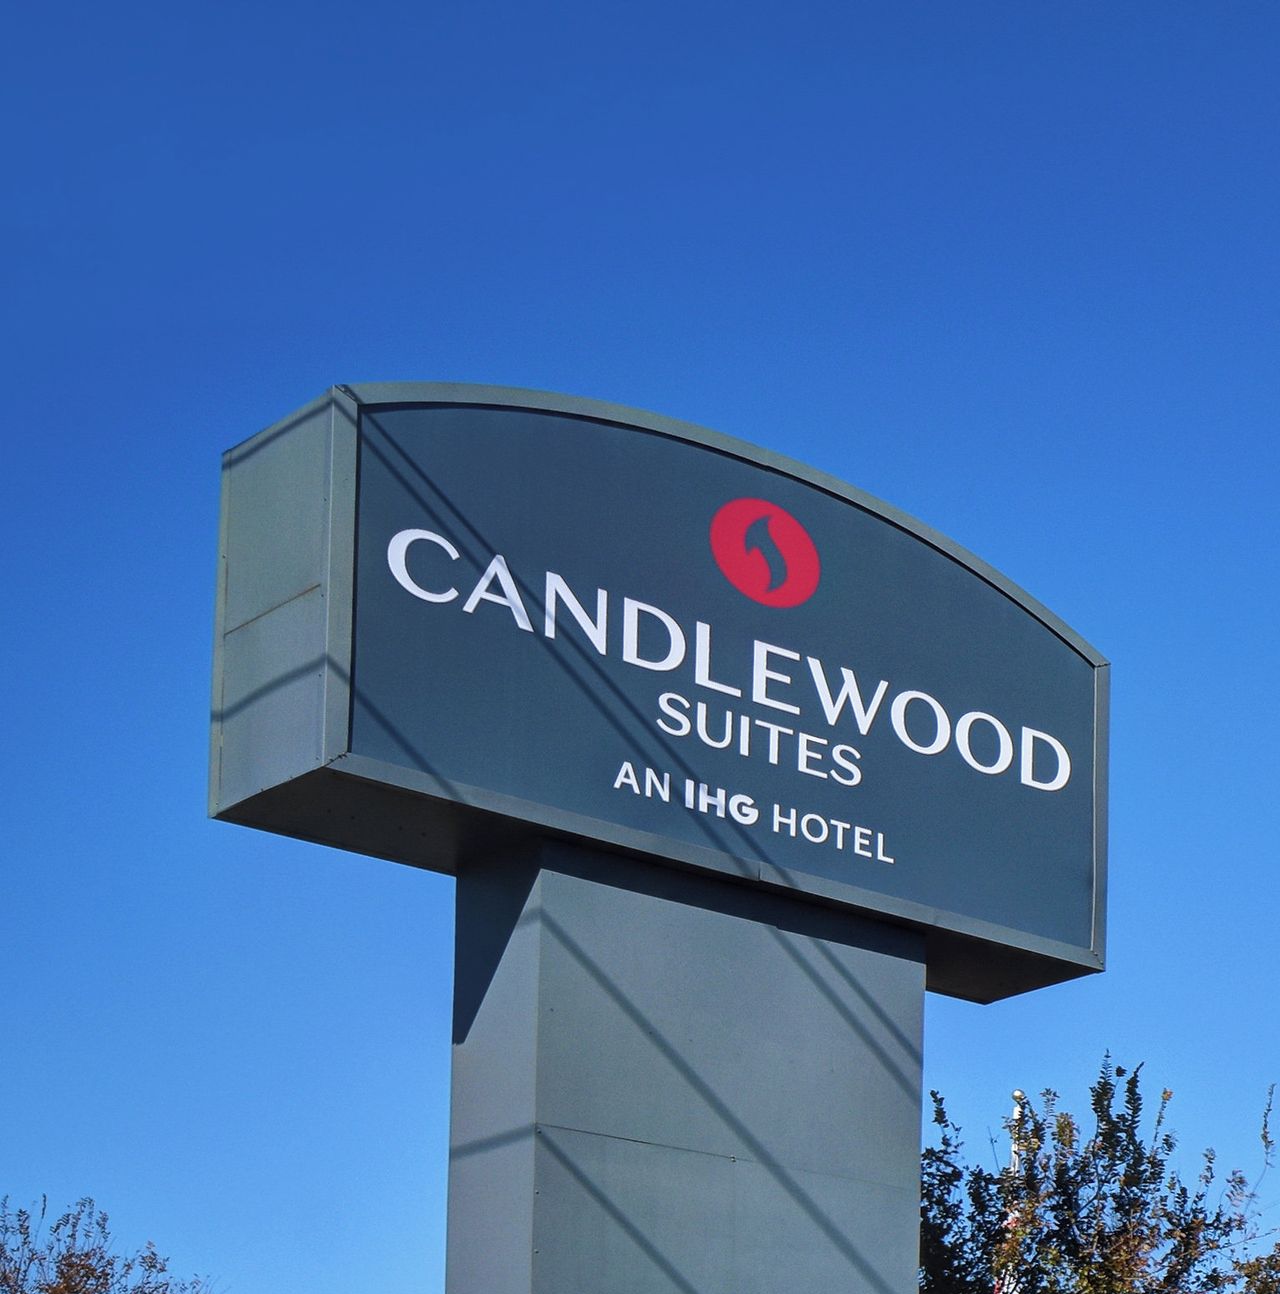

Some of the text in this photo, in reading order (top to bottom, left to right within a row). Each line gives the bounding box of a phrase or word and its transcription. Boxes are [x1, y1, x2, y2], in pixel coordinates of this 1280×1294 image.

[387, 528, 1071, 791] CANDLEWOOD
[657, 692, 862, 786] SUITES
[613, 761, 895, 863] AN IHG HOTEL
